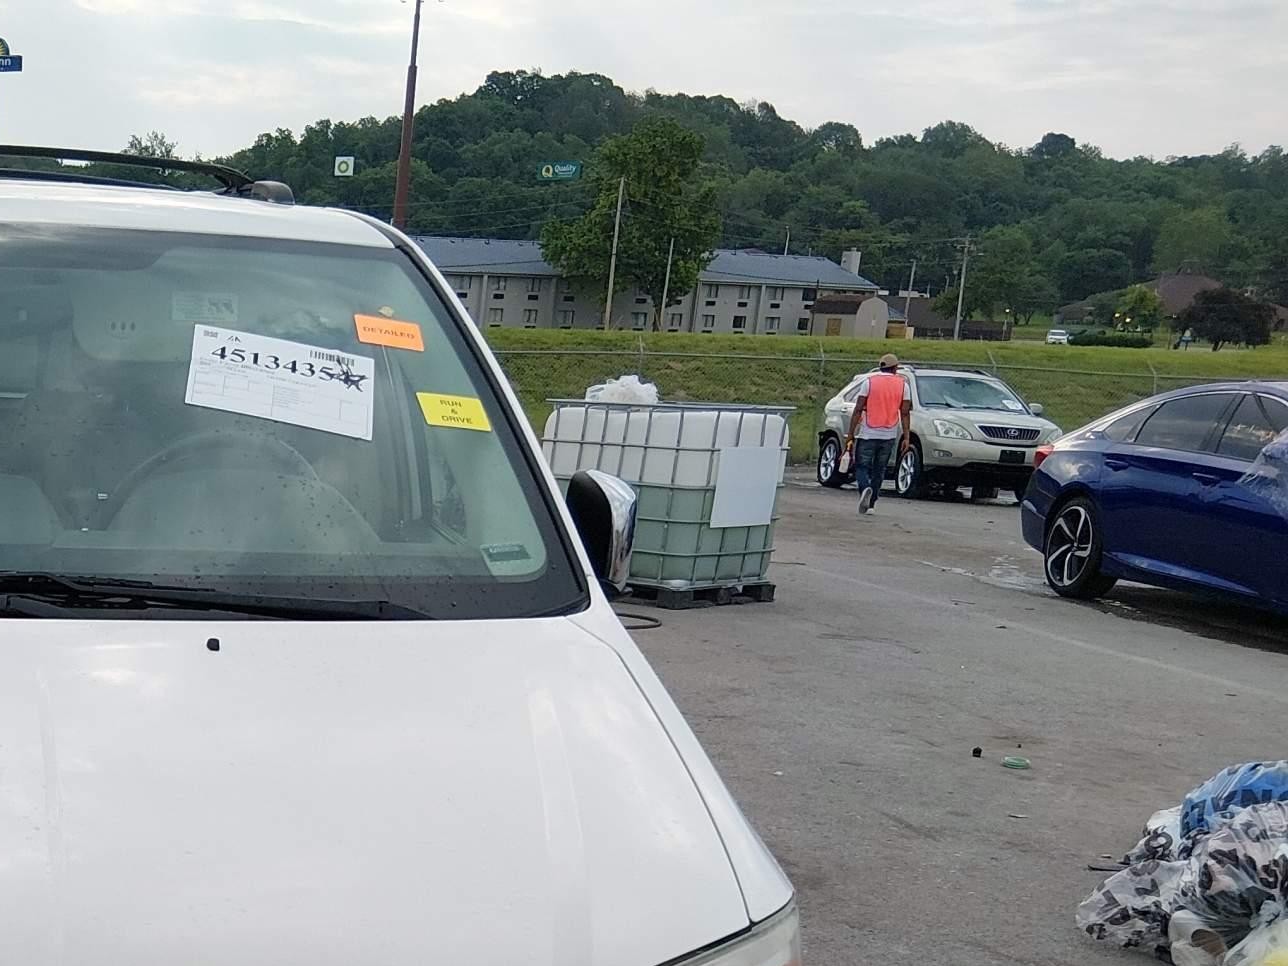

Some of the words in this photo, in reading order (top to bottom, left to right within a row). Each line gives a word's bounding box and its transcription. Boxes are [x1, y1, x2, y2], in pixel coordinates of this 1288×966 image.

[554, 163, 577, 174] Quality
[362, 325, 416, 340] DETAILED
[439, 399, 462, 408] RUN
[441, 415, 473, 425] DRIVE
